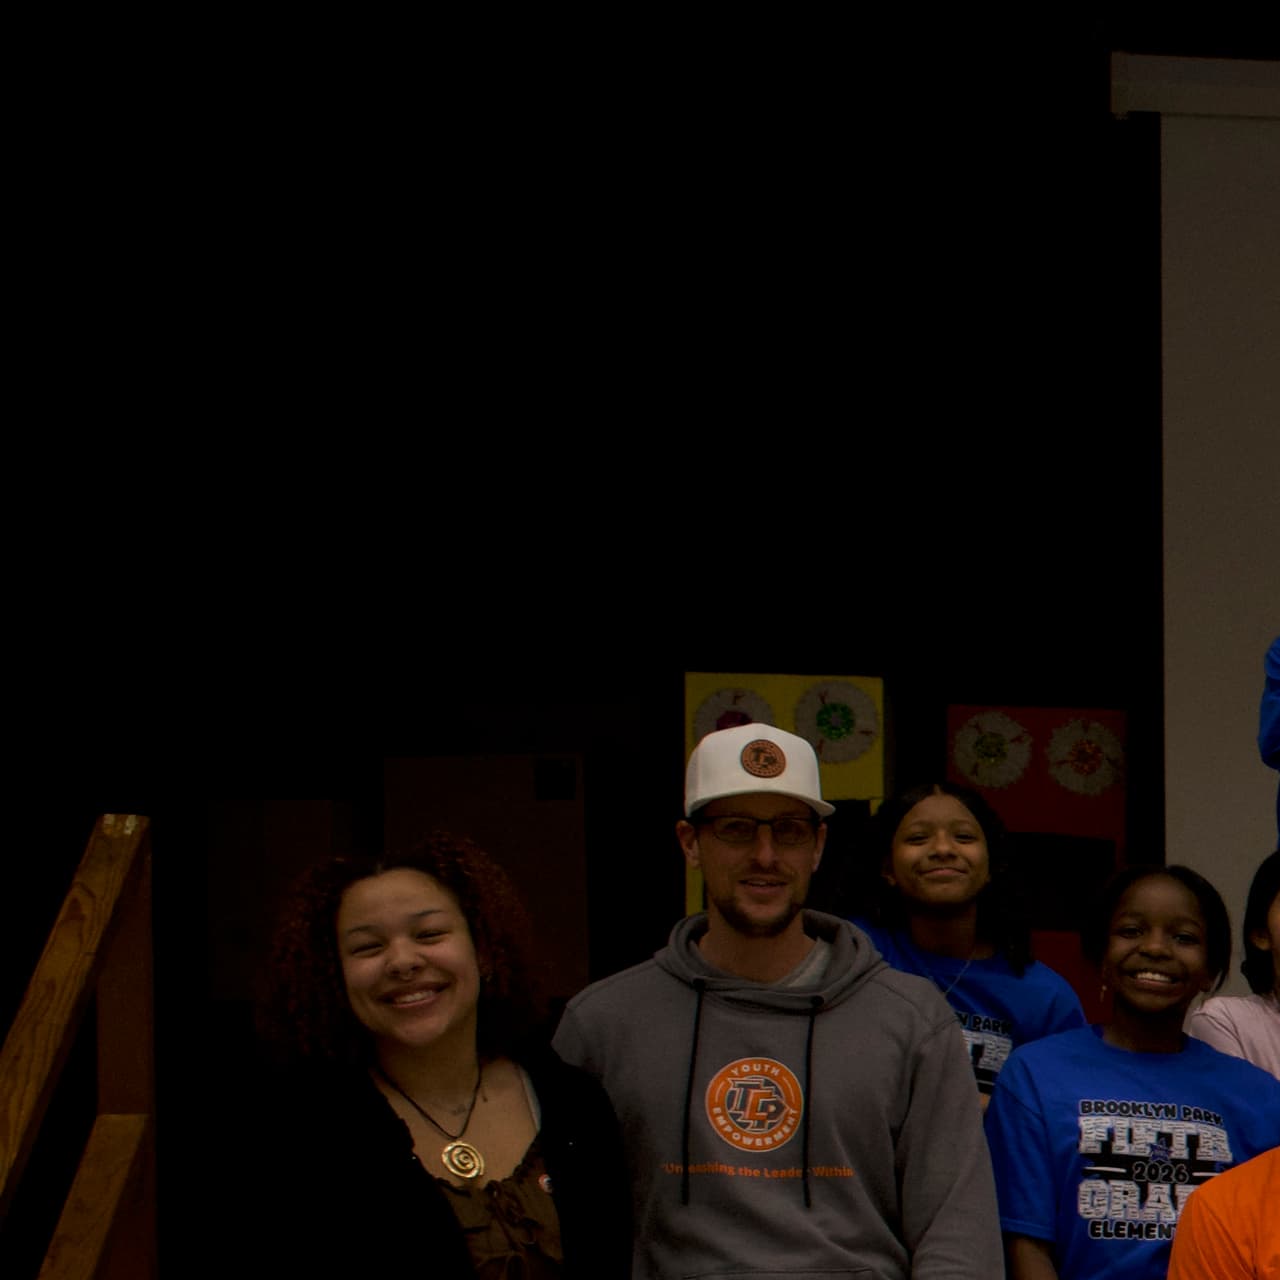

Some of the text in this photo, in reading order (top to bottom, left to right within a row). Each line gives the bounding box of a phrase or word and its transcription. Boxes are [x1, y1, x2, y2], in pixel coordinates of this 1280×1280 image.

[973, 1015, 1014, 1035] PARK
[731, 1063, 780, 1077] YOUTH
[1080, 1100, 1223, 1125] BROOKLYN PARK
[712, 1106, 799, 1147] EMPOWERMENT
[1078, 1115, 1233, 1164] FIFTH
[1131, 1162, 1190, 1184] 2026
